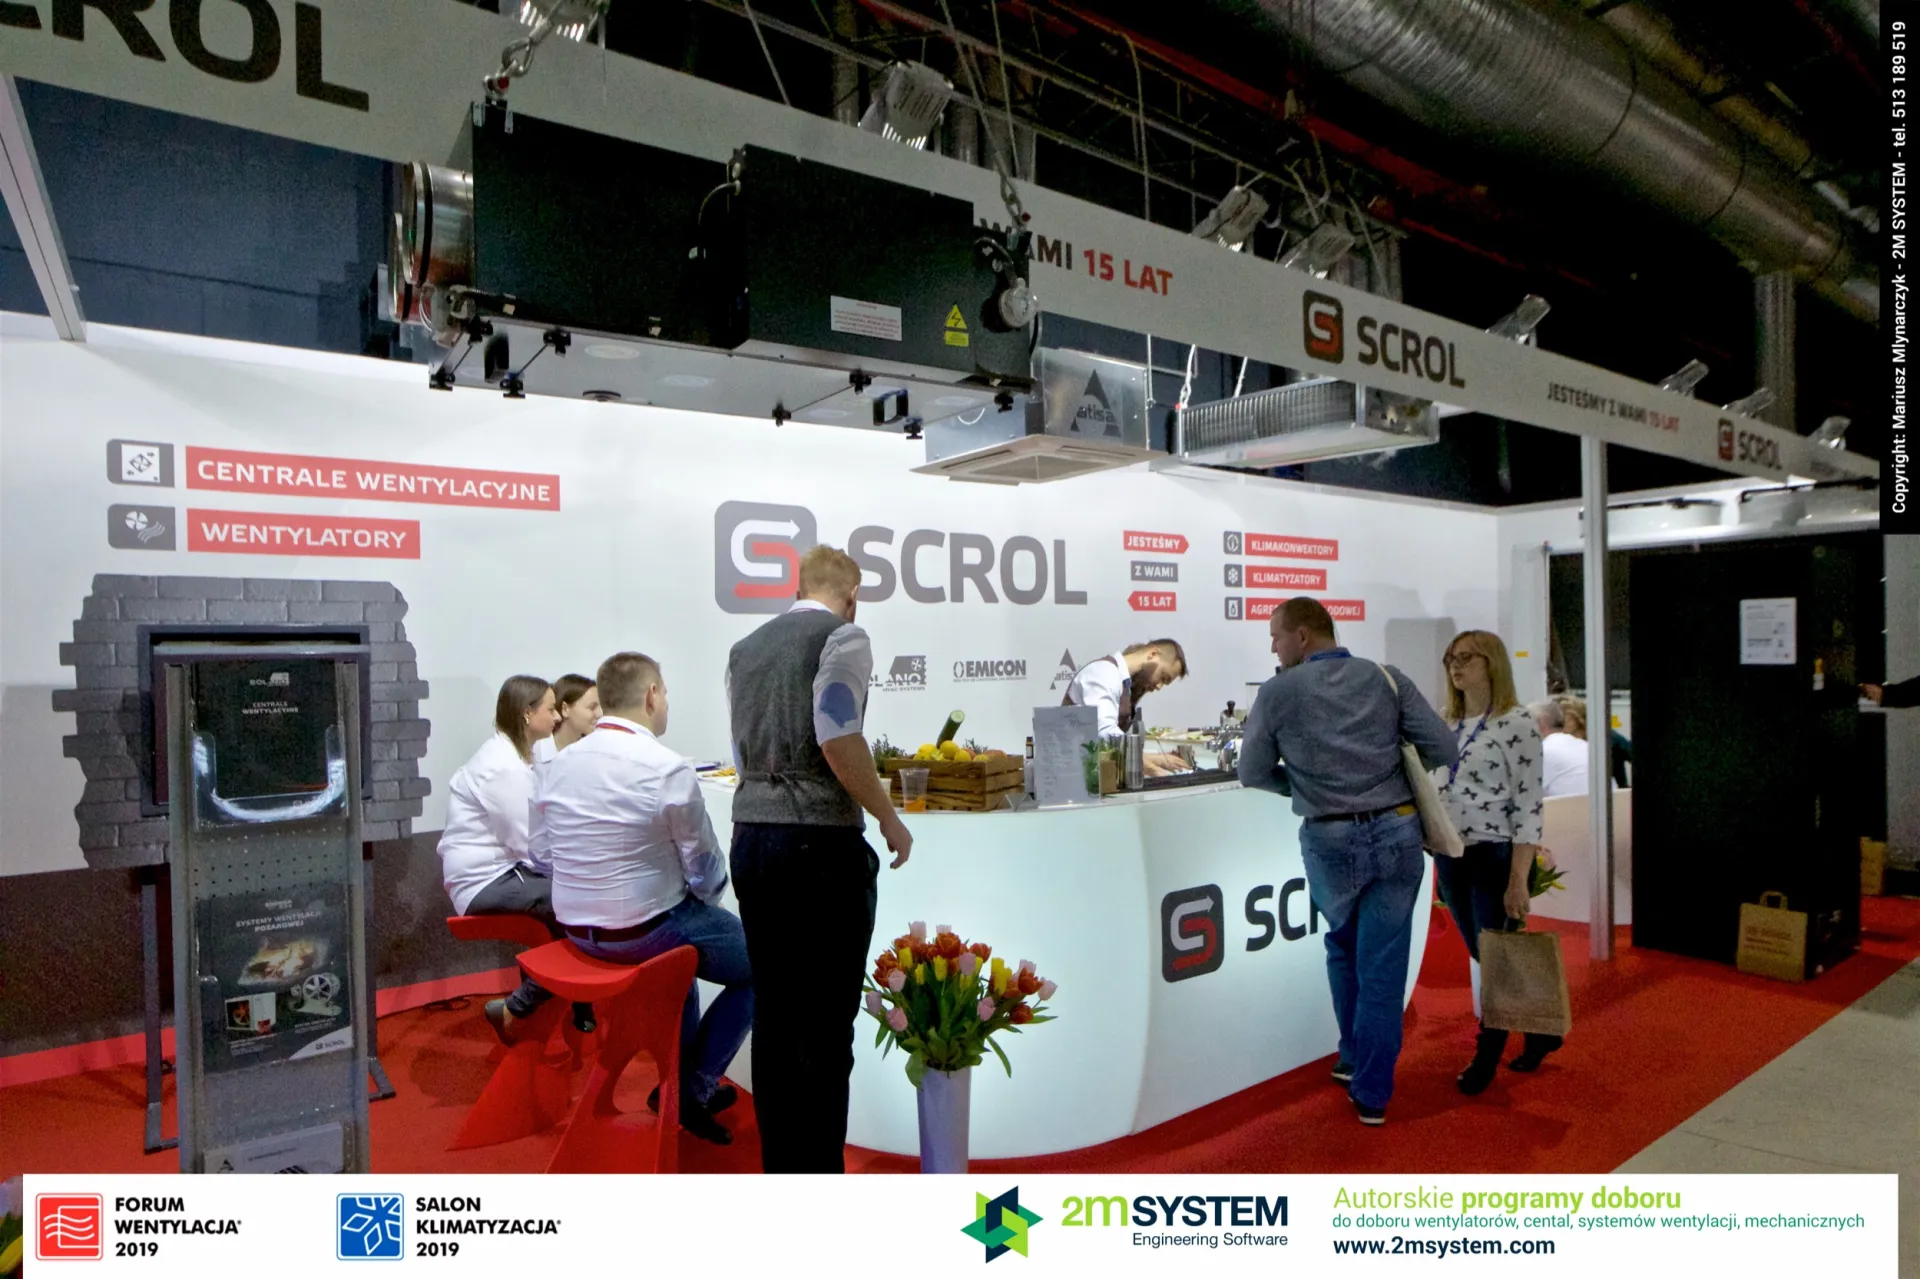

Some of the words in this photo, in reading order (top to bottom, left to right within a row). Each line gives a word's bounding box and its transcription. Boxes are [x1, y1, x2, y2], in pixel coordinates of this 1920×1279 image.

[0, 0, 369, 112] ROL
[1083, 249, 1115, 282] 15
[1123, 259, 1174, 297] LAT
[1356, 315, 1466, 389] SCROL
[1076, 404, 1116, 423] atisa
[1608, 398, 1617, 417] Z
[197, 459, 348, 490] CENTRALE
[355, 470, 551, 503] WENTYLACYJNE
[200, 521, 407, 549] WENTYLATORY
[1127, 535, 1181, 550] JESTEŚMY
[1251, 539, 1335, 556] KLIMAKONWEKTORY
[847, 524, 1088, 606] SCROL
[1134, 565, 1142, 576] Z
[1144, 565, 1174, 578] WAMI
[1252, 572, 1321, 585] KLIMATYZATORY
[1138, 595, 1150, 607] 15
[1152, 596, 1173, 608] LAT
[966, 660, 1027, 677] EMICON
